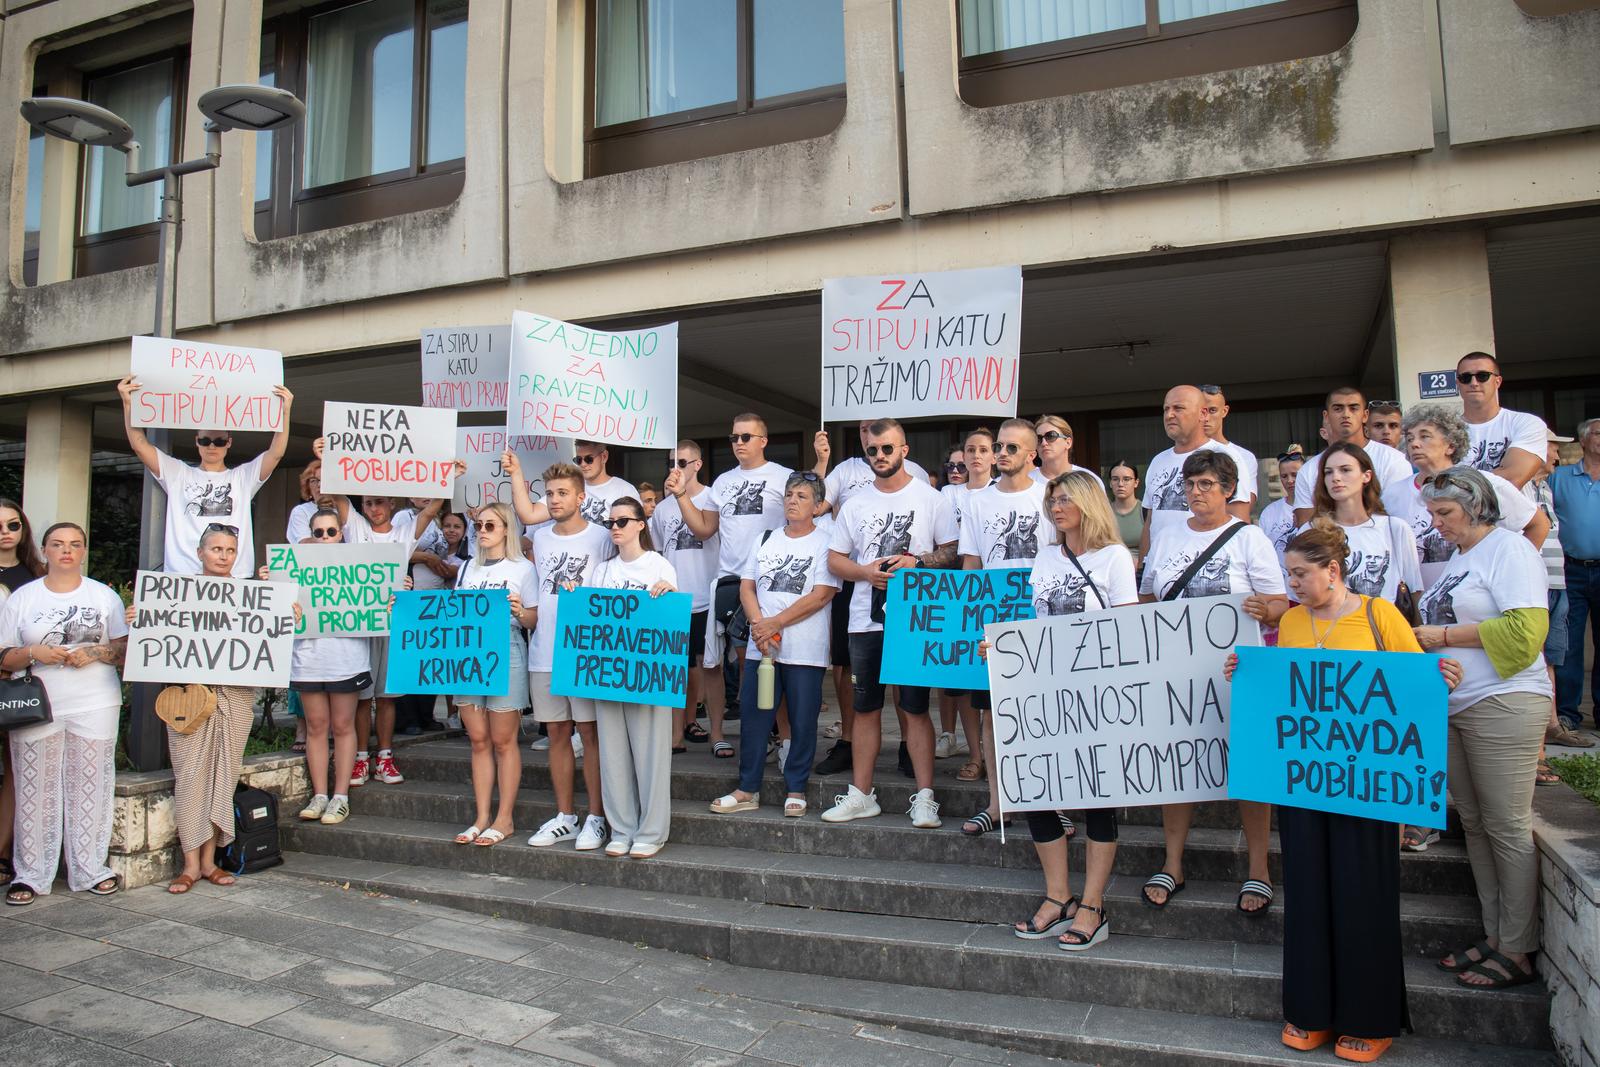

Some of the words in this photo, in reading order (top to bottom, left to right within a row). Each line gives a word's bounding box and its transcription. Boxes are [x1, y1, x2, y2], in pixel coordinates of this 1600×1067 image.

[876, 279, 935, 311] ZA
[426, 334, 444, 354] ZA
[448, 333, 478, 353] STIPU
[488, 333, 492, 352] I
[526, 317, 658, 359] ZAJEDNO
[832, 318, 917, 352] STIPU
[924, 318, 929, 349] I
[936, 312, 1006, 349] KATU
[170, 347, 256, 374] PRAVDA
[448, 357, 478, 375] KATU
[566, 355, 605, 382] ZA
[189, 374, 218, 391] ZA
[518, 374, 648, 411] PRAVEDNU
[823, 356, 931, 407] TRAŽIMO
[937, 356, 1017, 404] PRAVDU
[1430, 374, 1448, 388] 23
[140, 391, 207, 425] STIPU
[213, 396, 218, 424] I
[224, 393, 283, 429] KATU
[347, 409, 411, 431] NEKA
[327, 432, 414, 454] PRAVDA
[339, 457, 454, 487] POBIJEDI!
[269, 548, 299, 571] ZA
[289, 562, 400, 587] SIGURNOST
[140, 575, 236, 607] PRITVOR
[242, 585, 274, 611] NE
[311, 585, 393, 608] PRAVDU
[903, 571, 995, 601] PRAVDA
[1004, 571, 1033, 601] SE
[588, 593, 640, 620] STOP
[909, 604, 945, 633] NE
[266, 615, 294, 639] JE
[401, 625, 482, 651] PUSTITI
[563, 624, 690, 656] NEPRAVEDNIM
[138, 634, 275, 672] PRAVDA
[995, 626, 1054, 679] SVI
[418, 651, 499, 687] KRIVCA?
[574, 654, 687, 695] PRESUDAMA
[1290, 659, 1397, 716] NEKA
[997, 678, 1151, 745] SIGURNOST
[1165, 677, 1225, 726] NA
[1276, 714, 1424, 760] PRAVDA
